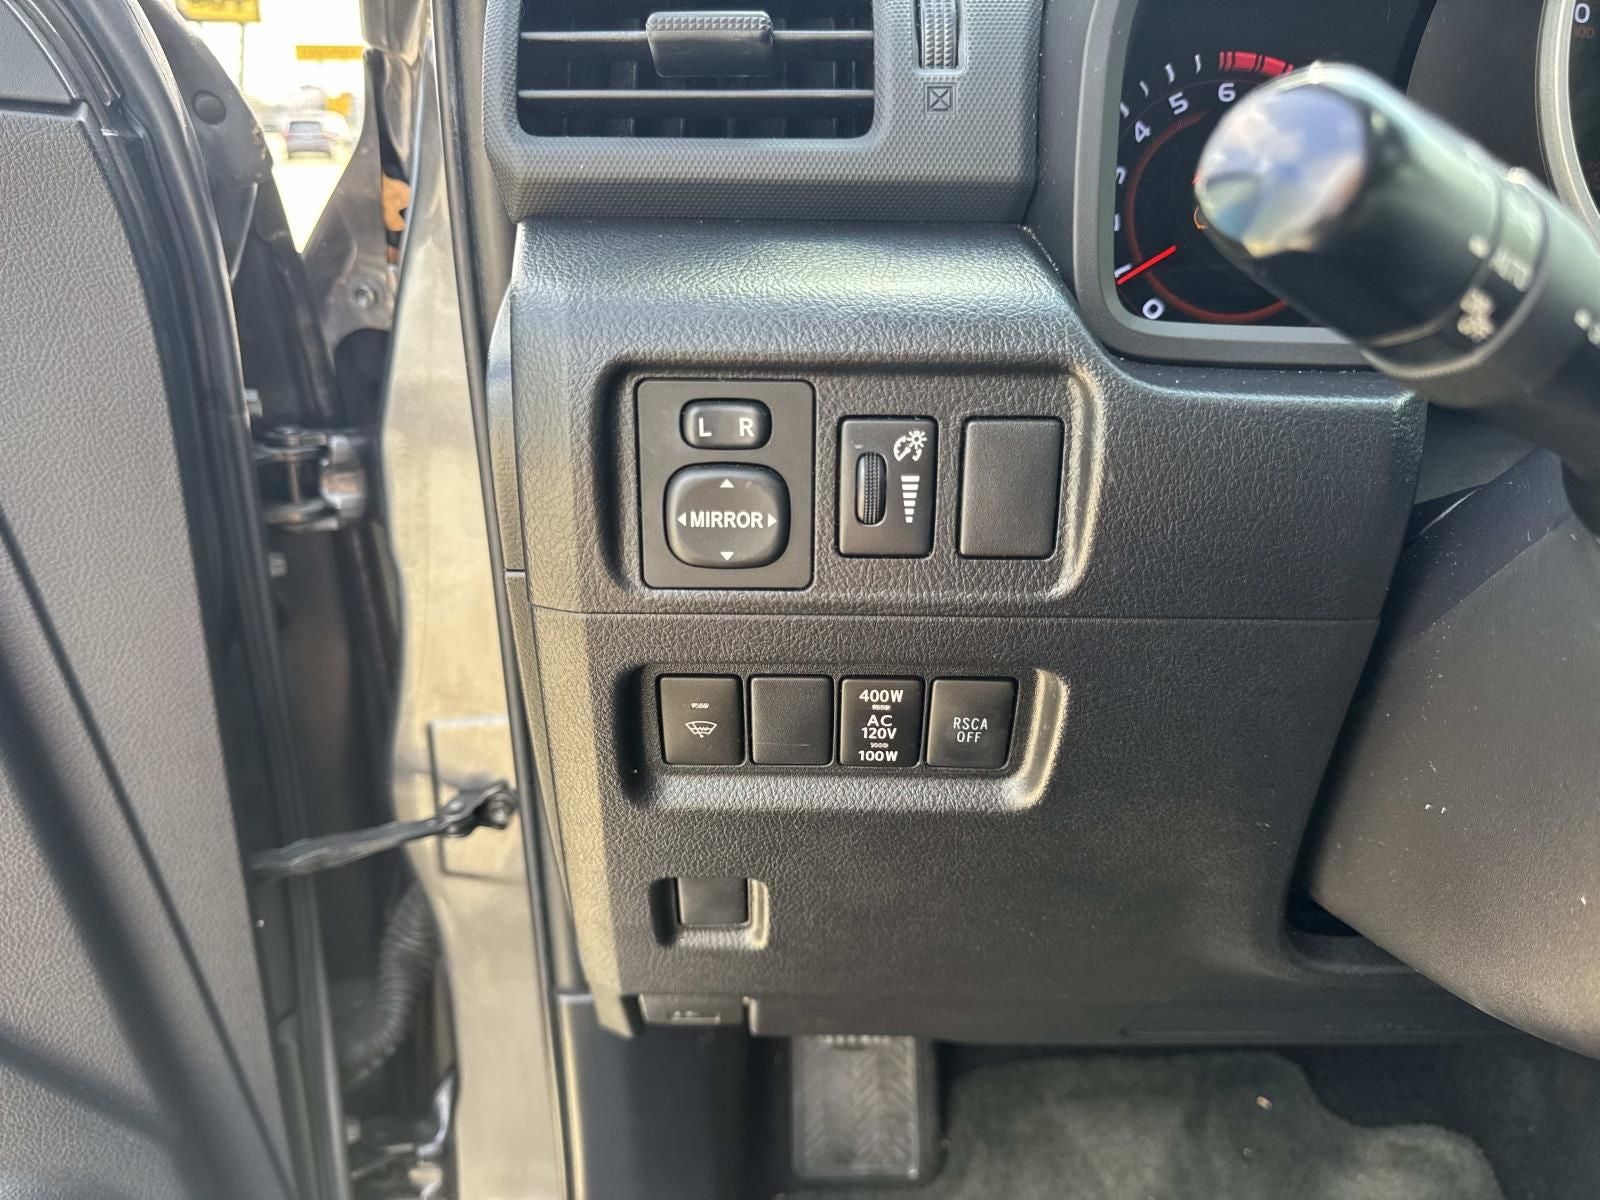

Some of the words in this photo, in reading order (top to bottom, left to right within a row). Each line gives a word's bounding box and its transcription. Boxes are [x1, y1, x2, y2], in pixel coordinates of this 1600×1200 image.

[1217, 82, 1237, 103] 6
[1168, 91, 1189, 115] 5
[1134, 120, 1151, 143] 4
[1142, 298, 1164, 320] 0
[698, 417, 712, 437] L
[739, 417, 755, 437] R
[690, 510, 764, 529] MIRROR
[859, 689, 904, 703] 400W
[867, 714, 893, 727] AC
[953, 716, 988, 730] RSCA
[861, 727, 897, 740] 120V
[956, 730, 982, 743] OFF
[858, 750, 899, 762] 100W
